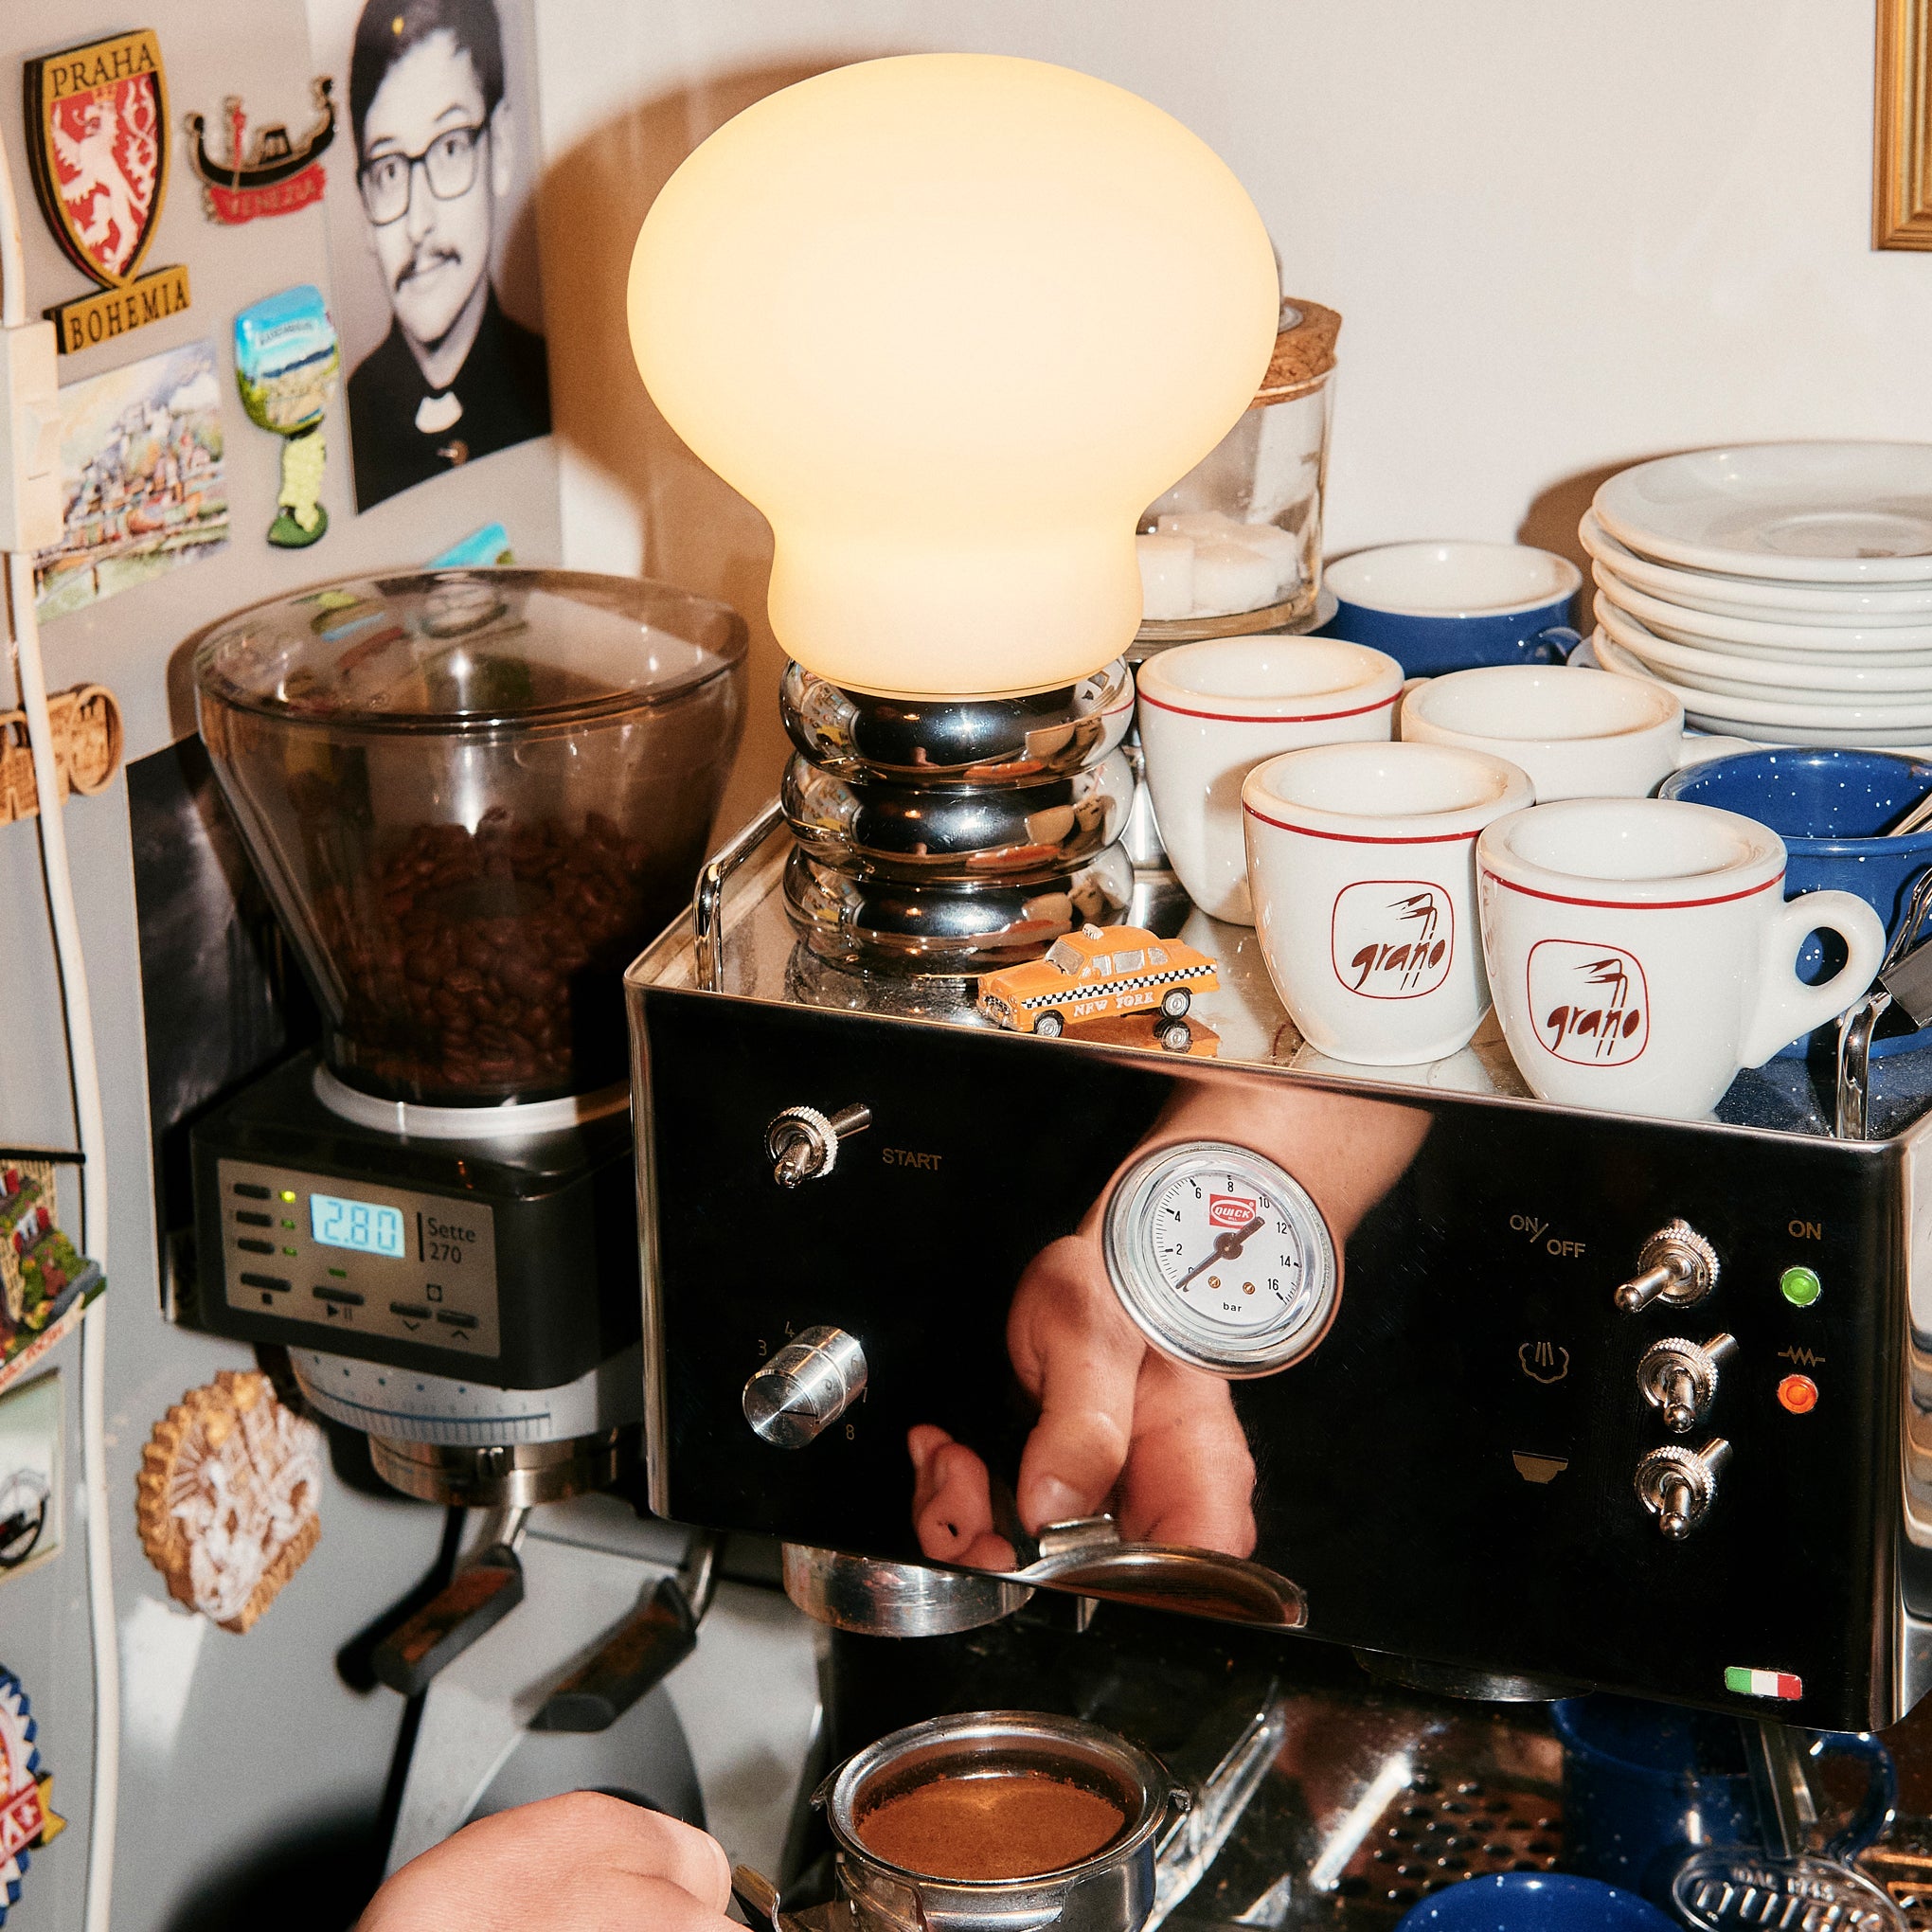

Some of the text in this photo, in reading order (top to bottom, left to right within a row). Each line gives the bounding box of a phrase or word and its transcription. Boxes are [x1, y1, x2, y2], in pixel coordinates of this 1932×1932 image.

[52, 43, 156, 98] PRAHA
[224, 177, 315, 216] VENEZIA
[70, 279, 189, 351] BOHEMIA
[1351, 939, 1446, 991] grano
[1073, 991, 1155, 1018] NEW YORK
[1547, 1005, 1640, 1053] grano
[882, 1148, 942, 1171] START
[1195, 1188, 1202, 1199] 6
[1227, 1181, 1234, 1192] 8
[1259, 1196, 1270, 1208] 10
[1174, 1211, 1181, 1222] 4
[1214, 1207, 1251, 1219] QUICK
[324, 1201, 397, 1251] 2.80
[427, 1217, 476, 1243] Sette
[1276, 1222, 1287, 1234] 12
[1788, 1220, 1822, 1241] ON
[429, 1243, 462, 1265] 270
[1176, 1243, 1183, 1256] 2
[1279, 1255, 1291, 1267] 14
[1267, 1279, 1279, 1291] 16
[1223, 1302, 1243, 1313] bar
[784, 1320, 795, 1338] 4
[758, 1339, 767, 1356] 3
[846, 1423, 855, 1440] 8
